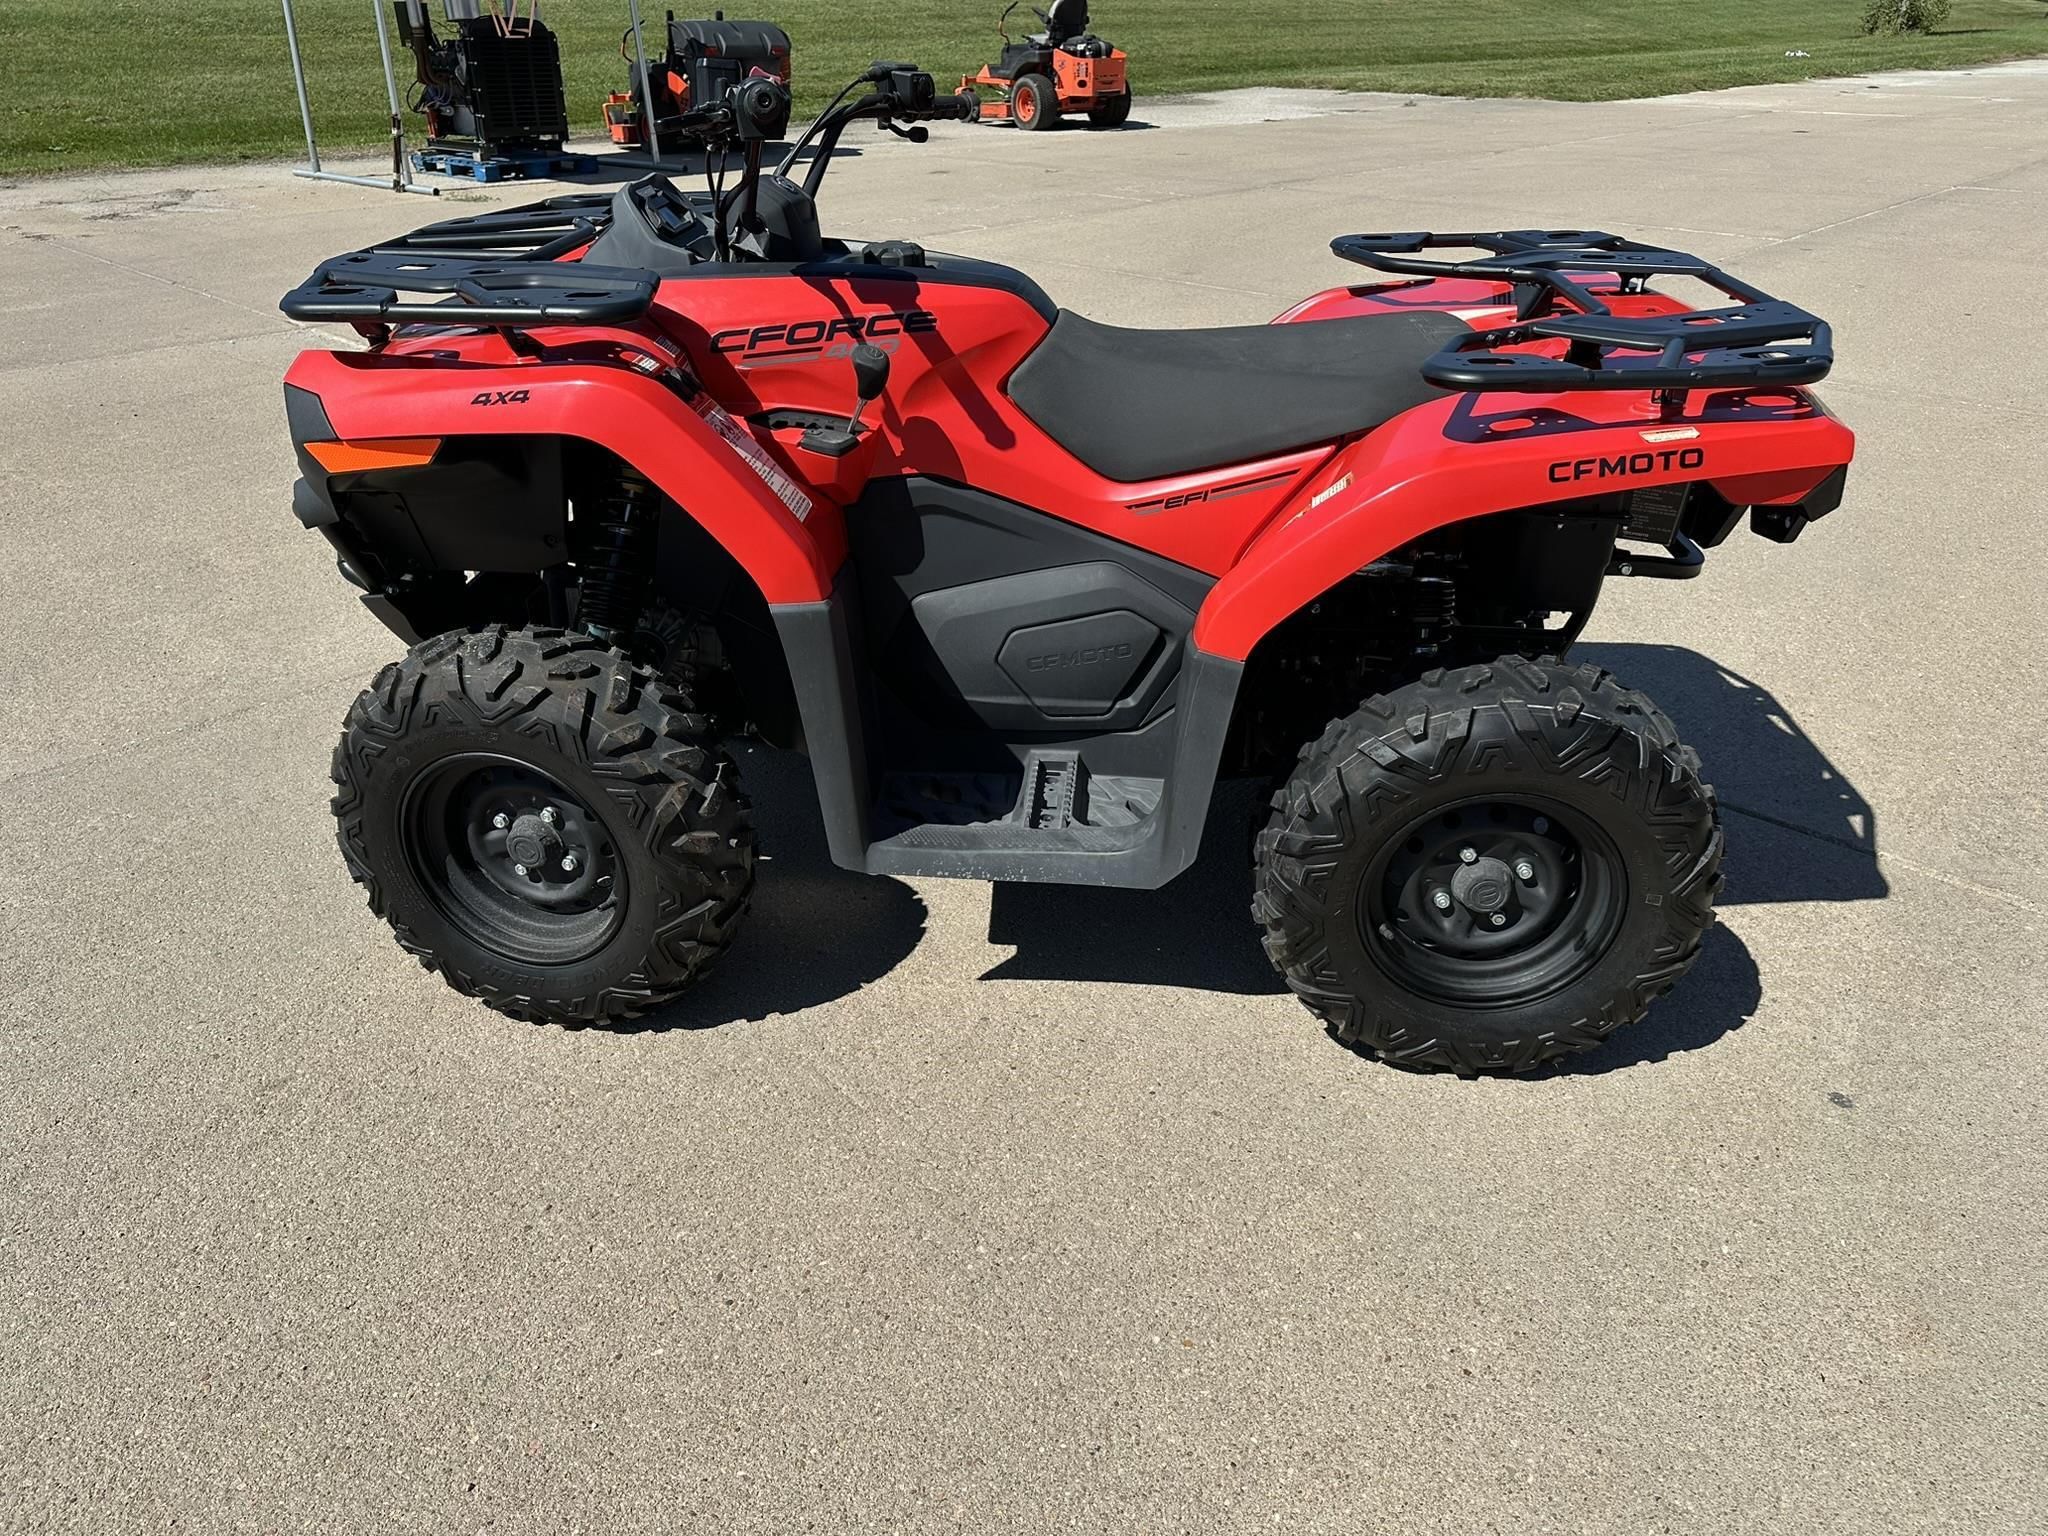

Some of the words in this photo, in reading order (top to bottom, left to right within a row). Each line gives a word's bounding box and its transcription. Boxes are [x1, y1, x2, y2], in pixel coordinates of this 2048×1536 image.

[710, 311, 937, 354] CFORCE
[1549, 448, 1704, 483] CFMOTO
[1164, 490, 1209, 509] EFI
[1026, 643, 1133, 673] CFMOTO
